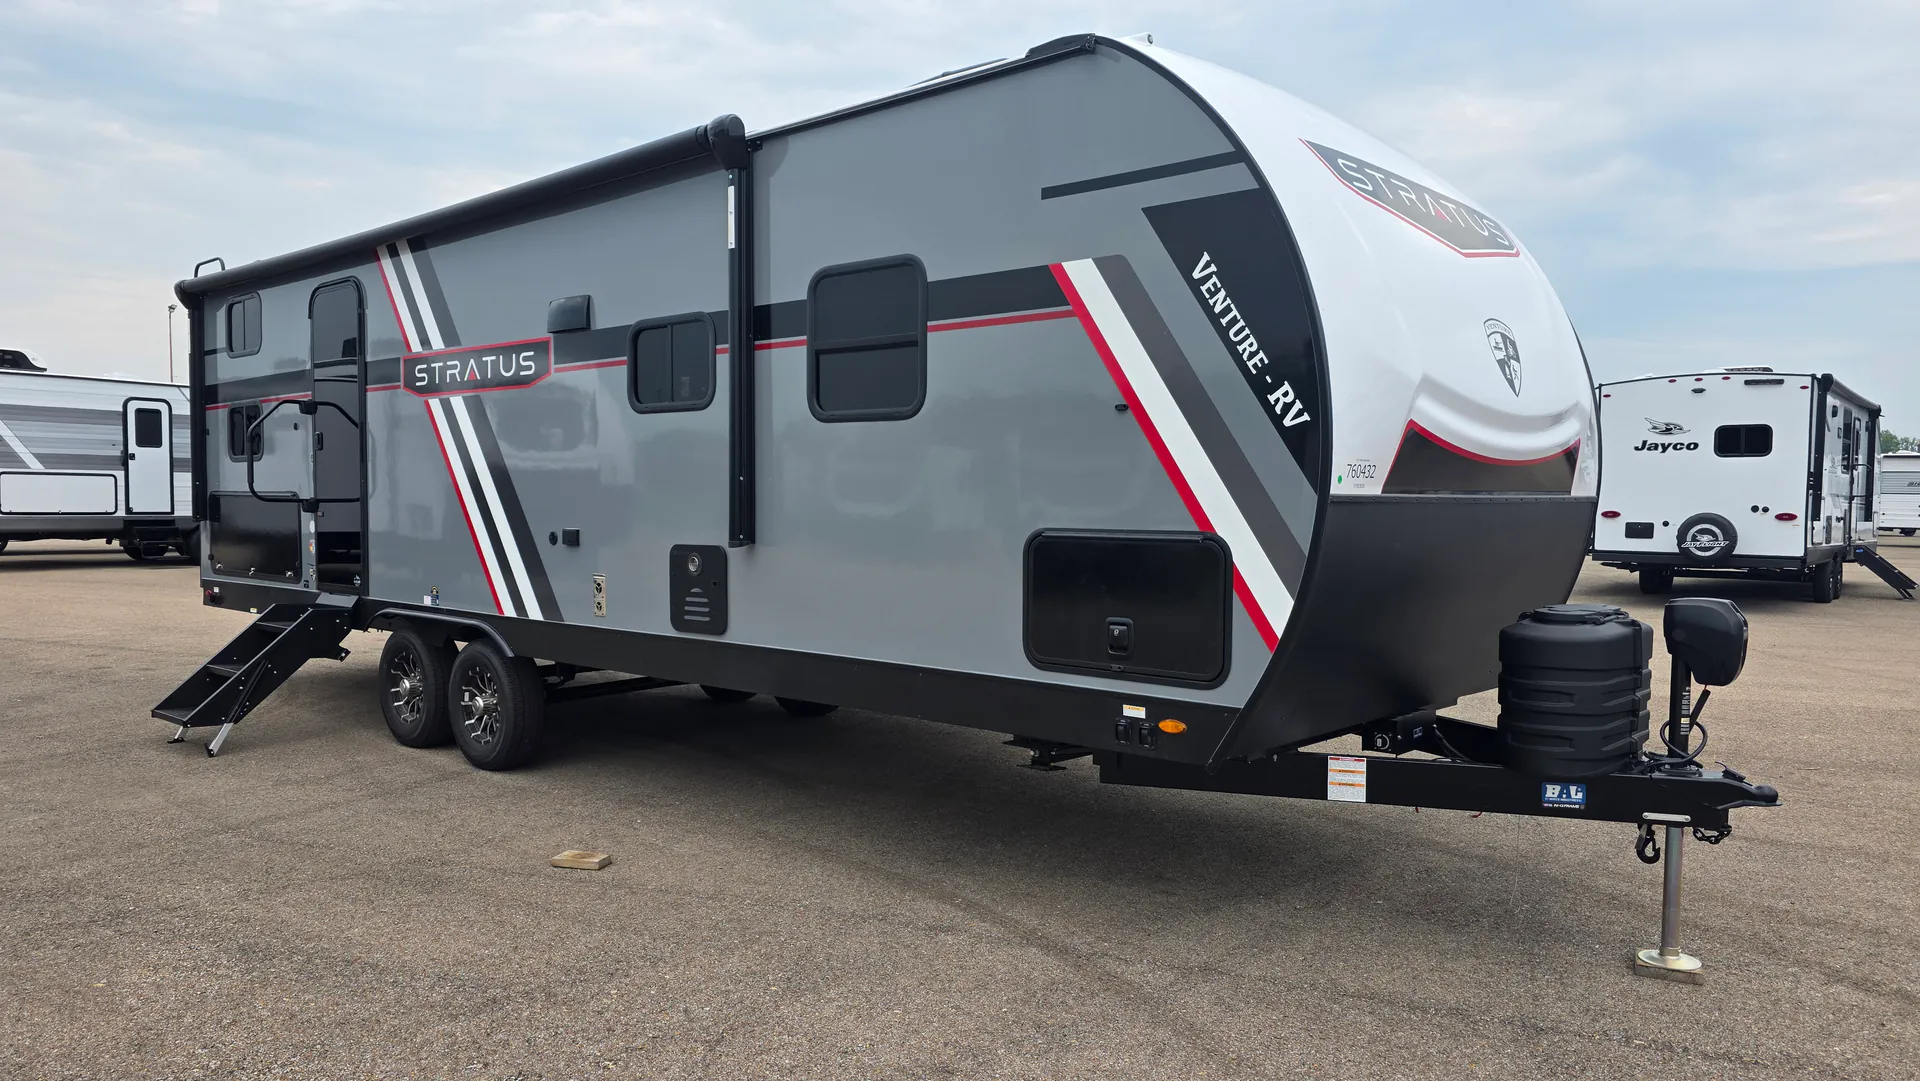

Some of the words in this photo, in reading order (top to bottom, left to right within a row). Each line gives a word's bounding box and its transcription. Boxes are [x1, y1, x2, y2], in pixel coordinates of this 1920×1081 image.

[1337, 158, 1509, 245] STRATUS
[1192, 251, 1269, 375] VENTURE
[1267, 381, 1311, 427] RV
[414, 351, 535, 386] STRATUS
[1633, 439, 1699, 454] Jayco
[1346, 463, 1377, 479] 760432
